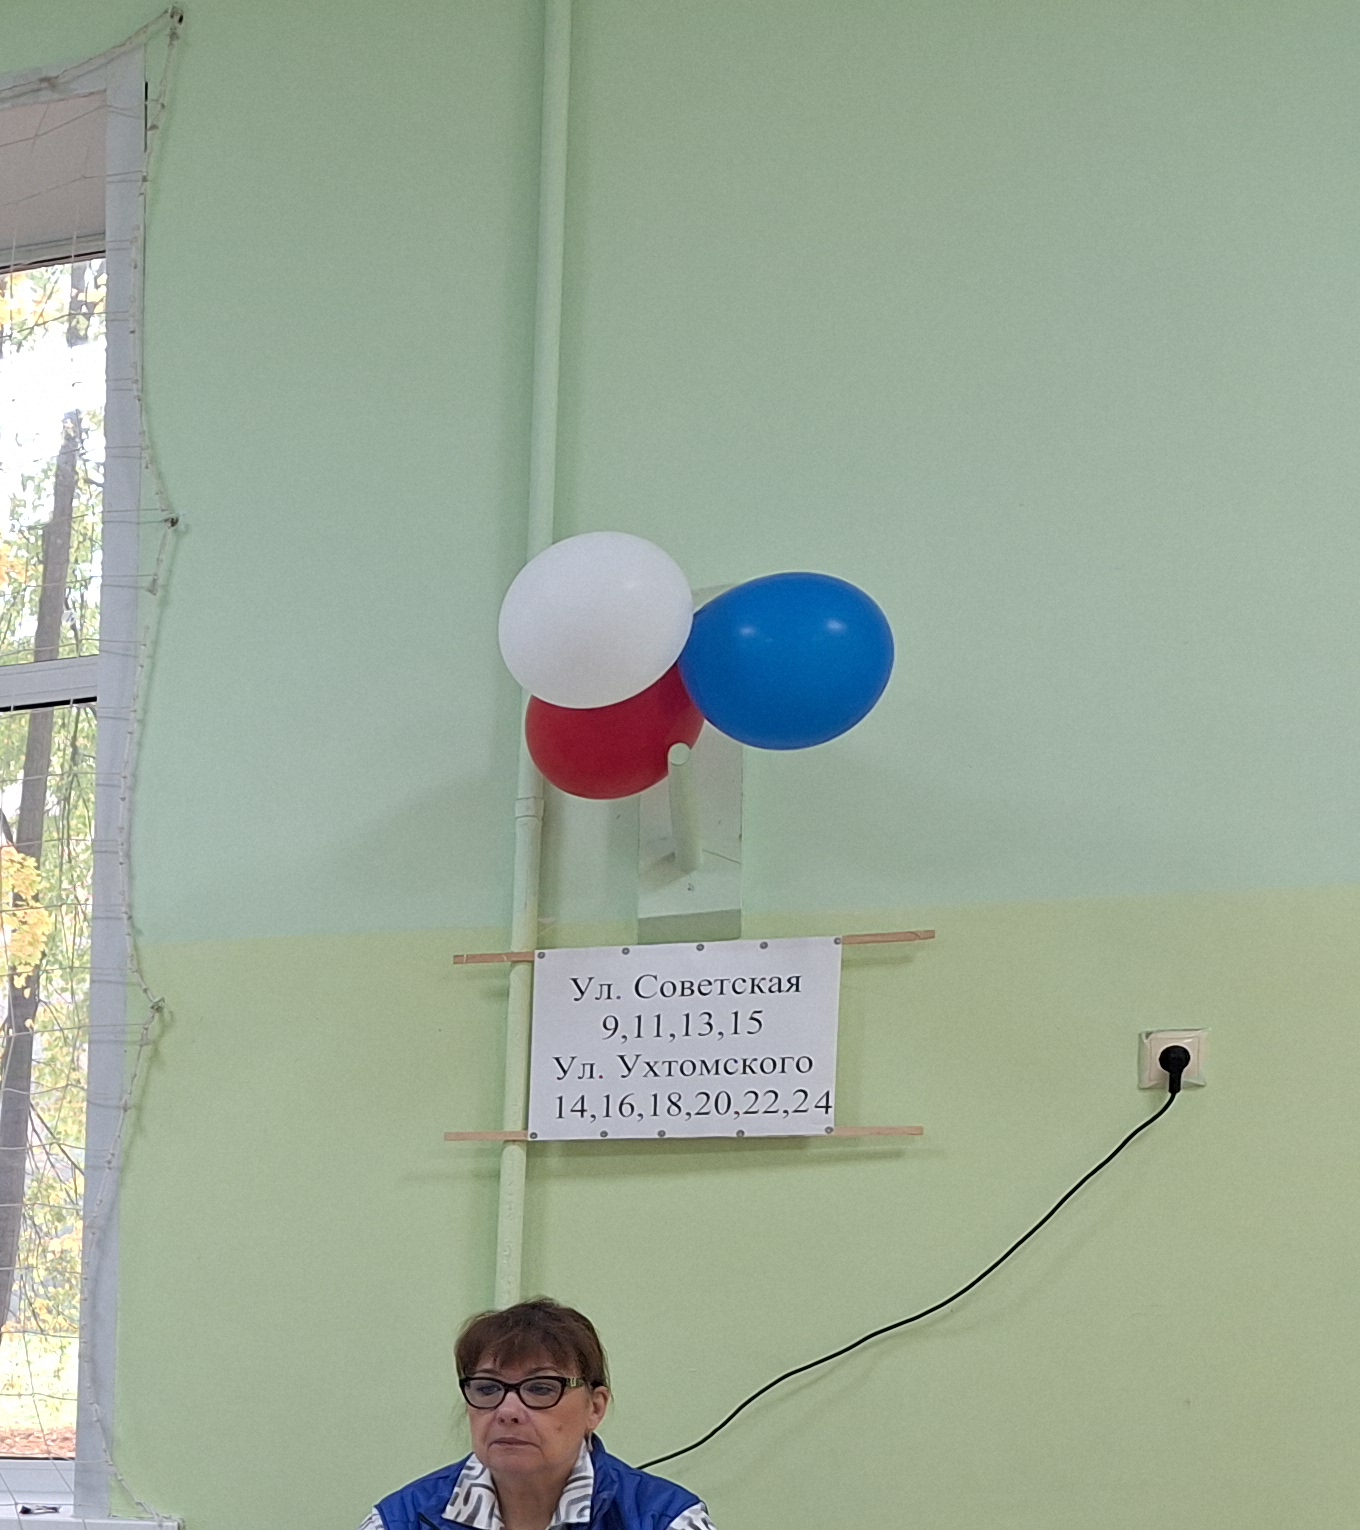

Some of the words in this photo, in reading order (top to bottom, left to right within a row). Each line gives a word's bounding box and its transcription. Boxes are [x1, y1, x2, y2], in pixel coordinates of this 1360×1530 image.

[569, 976, 621, 1002] Ул.
[634, 974, 802, 999] Советская
[602, 1009, 764, 1044] 9,11,13,15
[552, 1055, 604, 1081] Ул.
[616, 1053, 813, 1079] Ухтомского
[557, 1088, 833, 1123] 14,16,18,20,22,24
